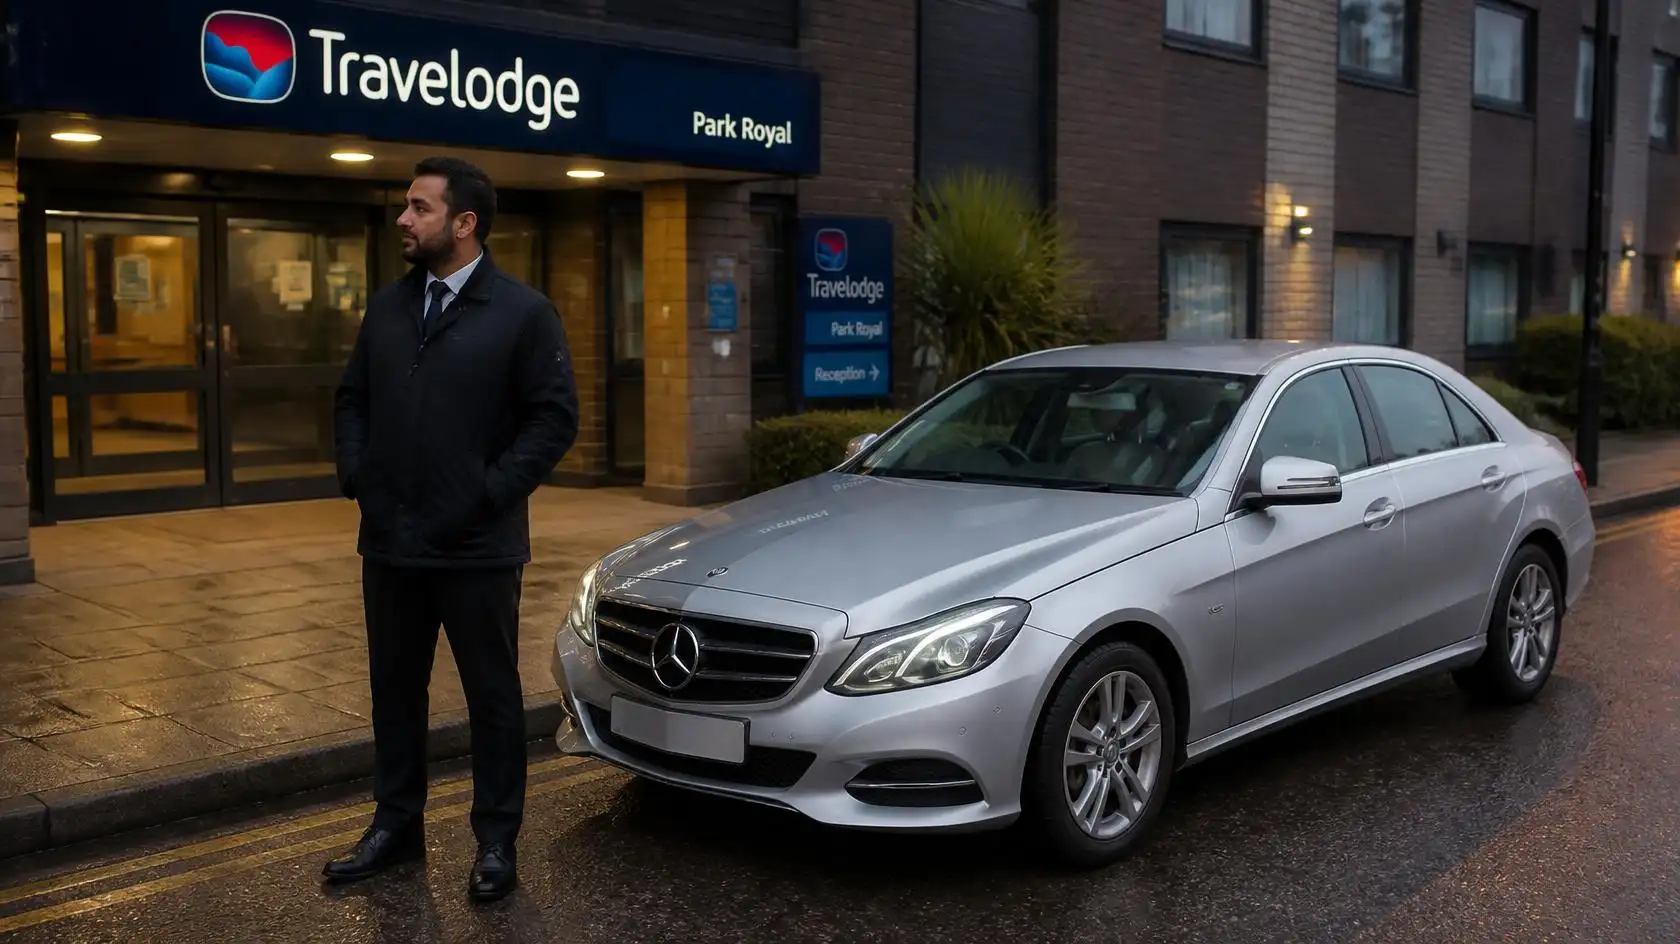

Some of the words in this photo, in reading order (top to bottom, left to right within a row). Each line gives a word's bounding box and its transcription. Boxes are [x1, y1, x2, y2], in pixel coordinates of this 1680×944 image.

[308, 28, 580, 131] Travelodge
[693, 111, 737, 138] Park
[741, 117, 793, 148] Royal
[807, 273, 884, 304] Travelodge
[831, 321, 854, 336] Park
[856, 321, 883, 339] Royal
[814, 366, 866, 384] Reception
